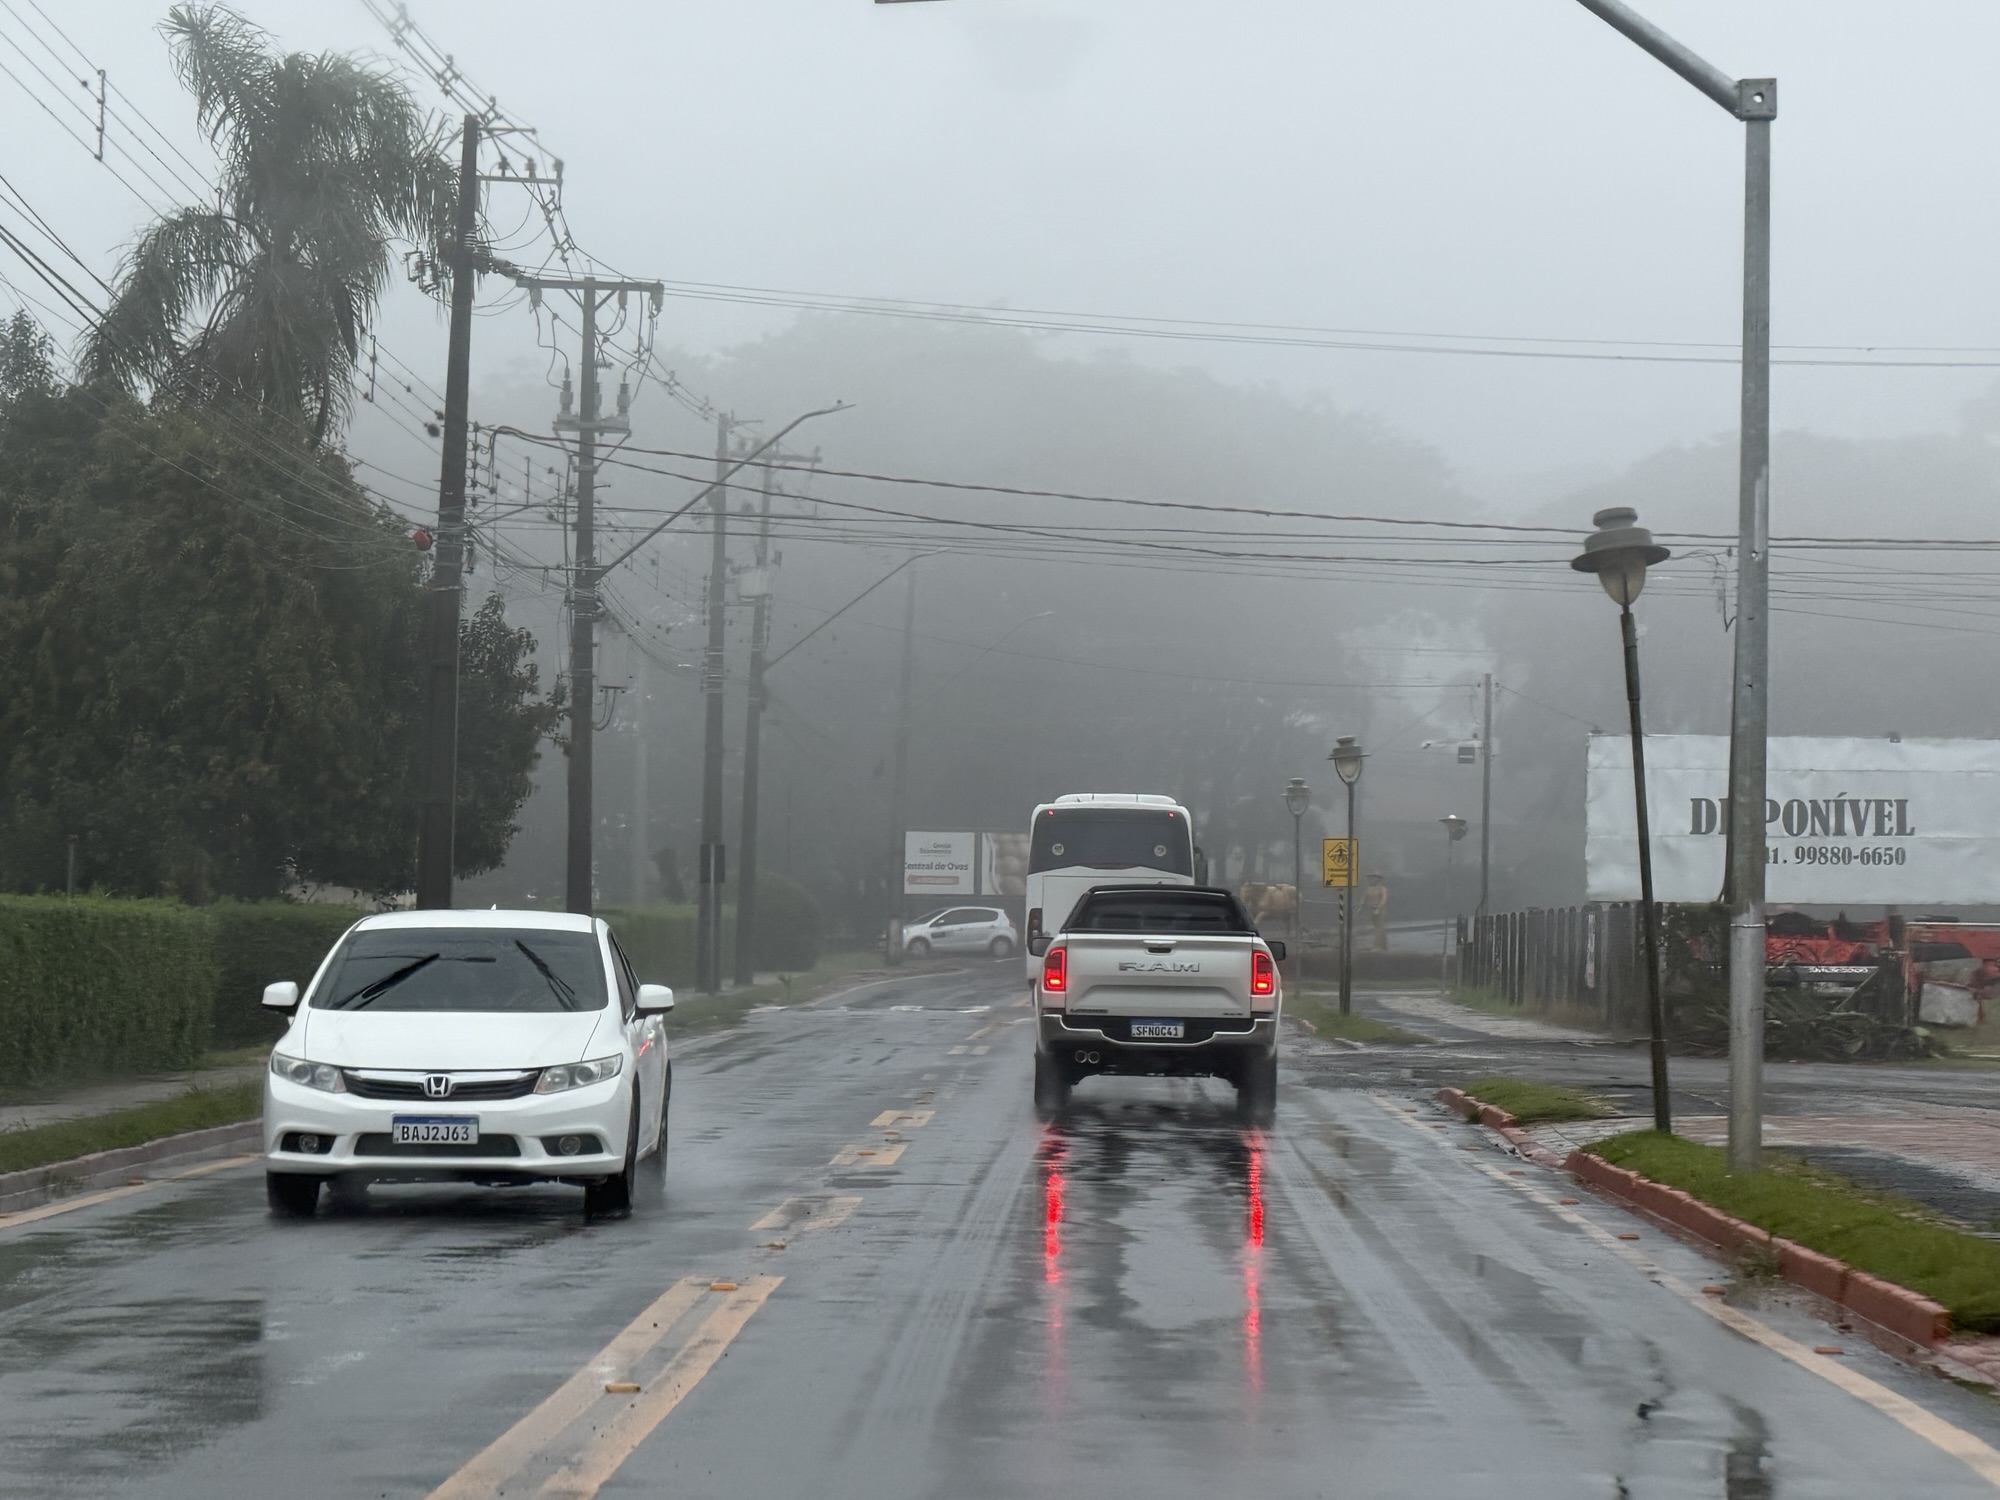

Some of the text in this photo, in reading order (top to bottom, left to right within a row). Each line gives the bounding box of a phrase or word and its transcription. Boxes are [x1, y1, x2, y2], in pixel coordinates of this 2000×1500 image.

[1689, 792, 1916, 837] DIPONÍVEL
[1794, 846, 1907, 866] 99880-6650
[934, 861, 946, 870] de
[947, 862, 969, 871] Ovos
[1118, 962, 1201, 973] RAM
[401, 1125, 470, 1142] BAJ2J63
